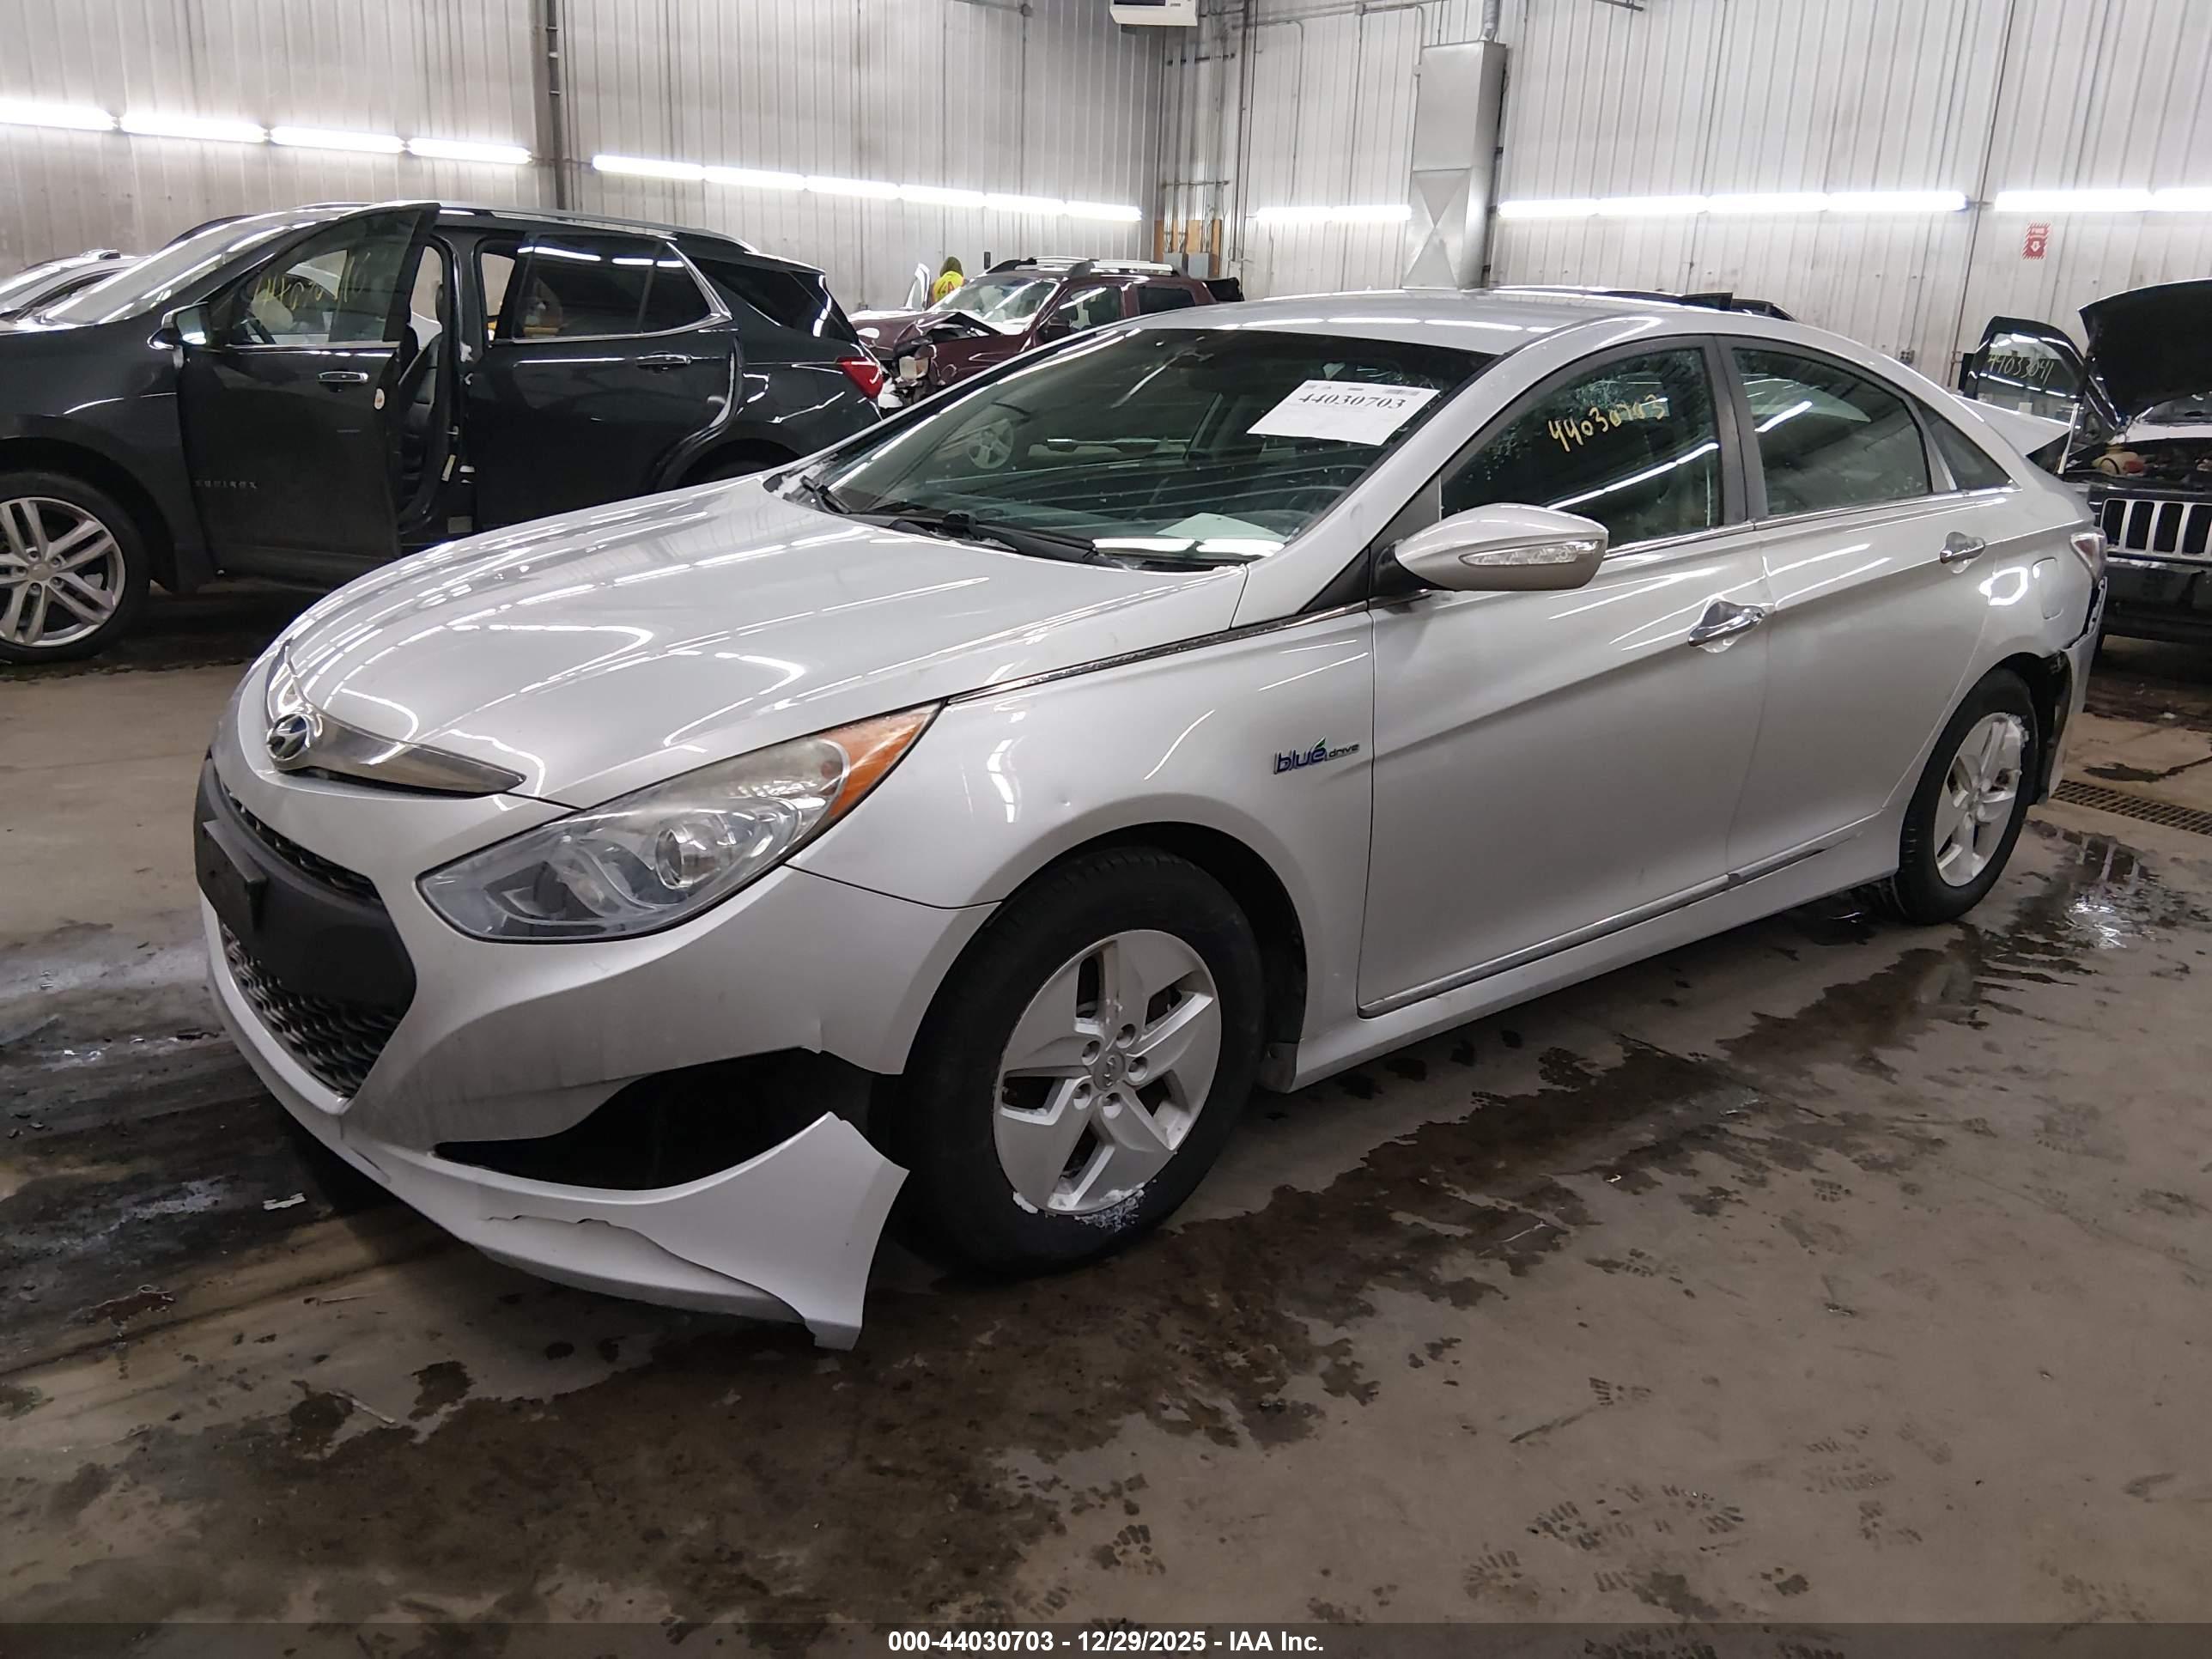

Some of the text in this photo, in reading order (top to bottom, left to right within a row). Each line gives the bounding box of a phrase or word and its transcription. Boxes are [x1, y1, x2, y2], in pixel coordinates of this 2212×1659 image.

[1987, 355, 2054, 386] 44033041
[1298, 393, 1407, 410] 44030703
[1548, 393, 1665, 453] 44030703
